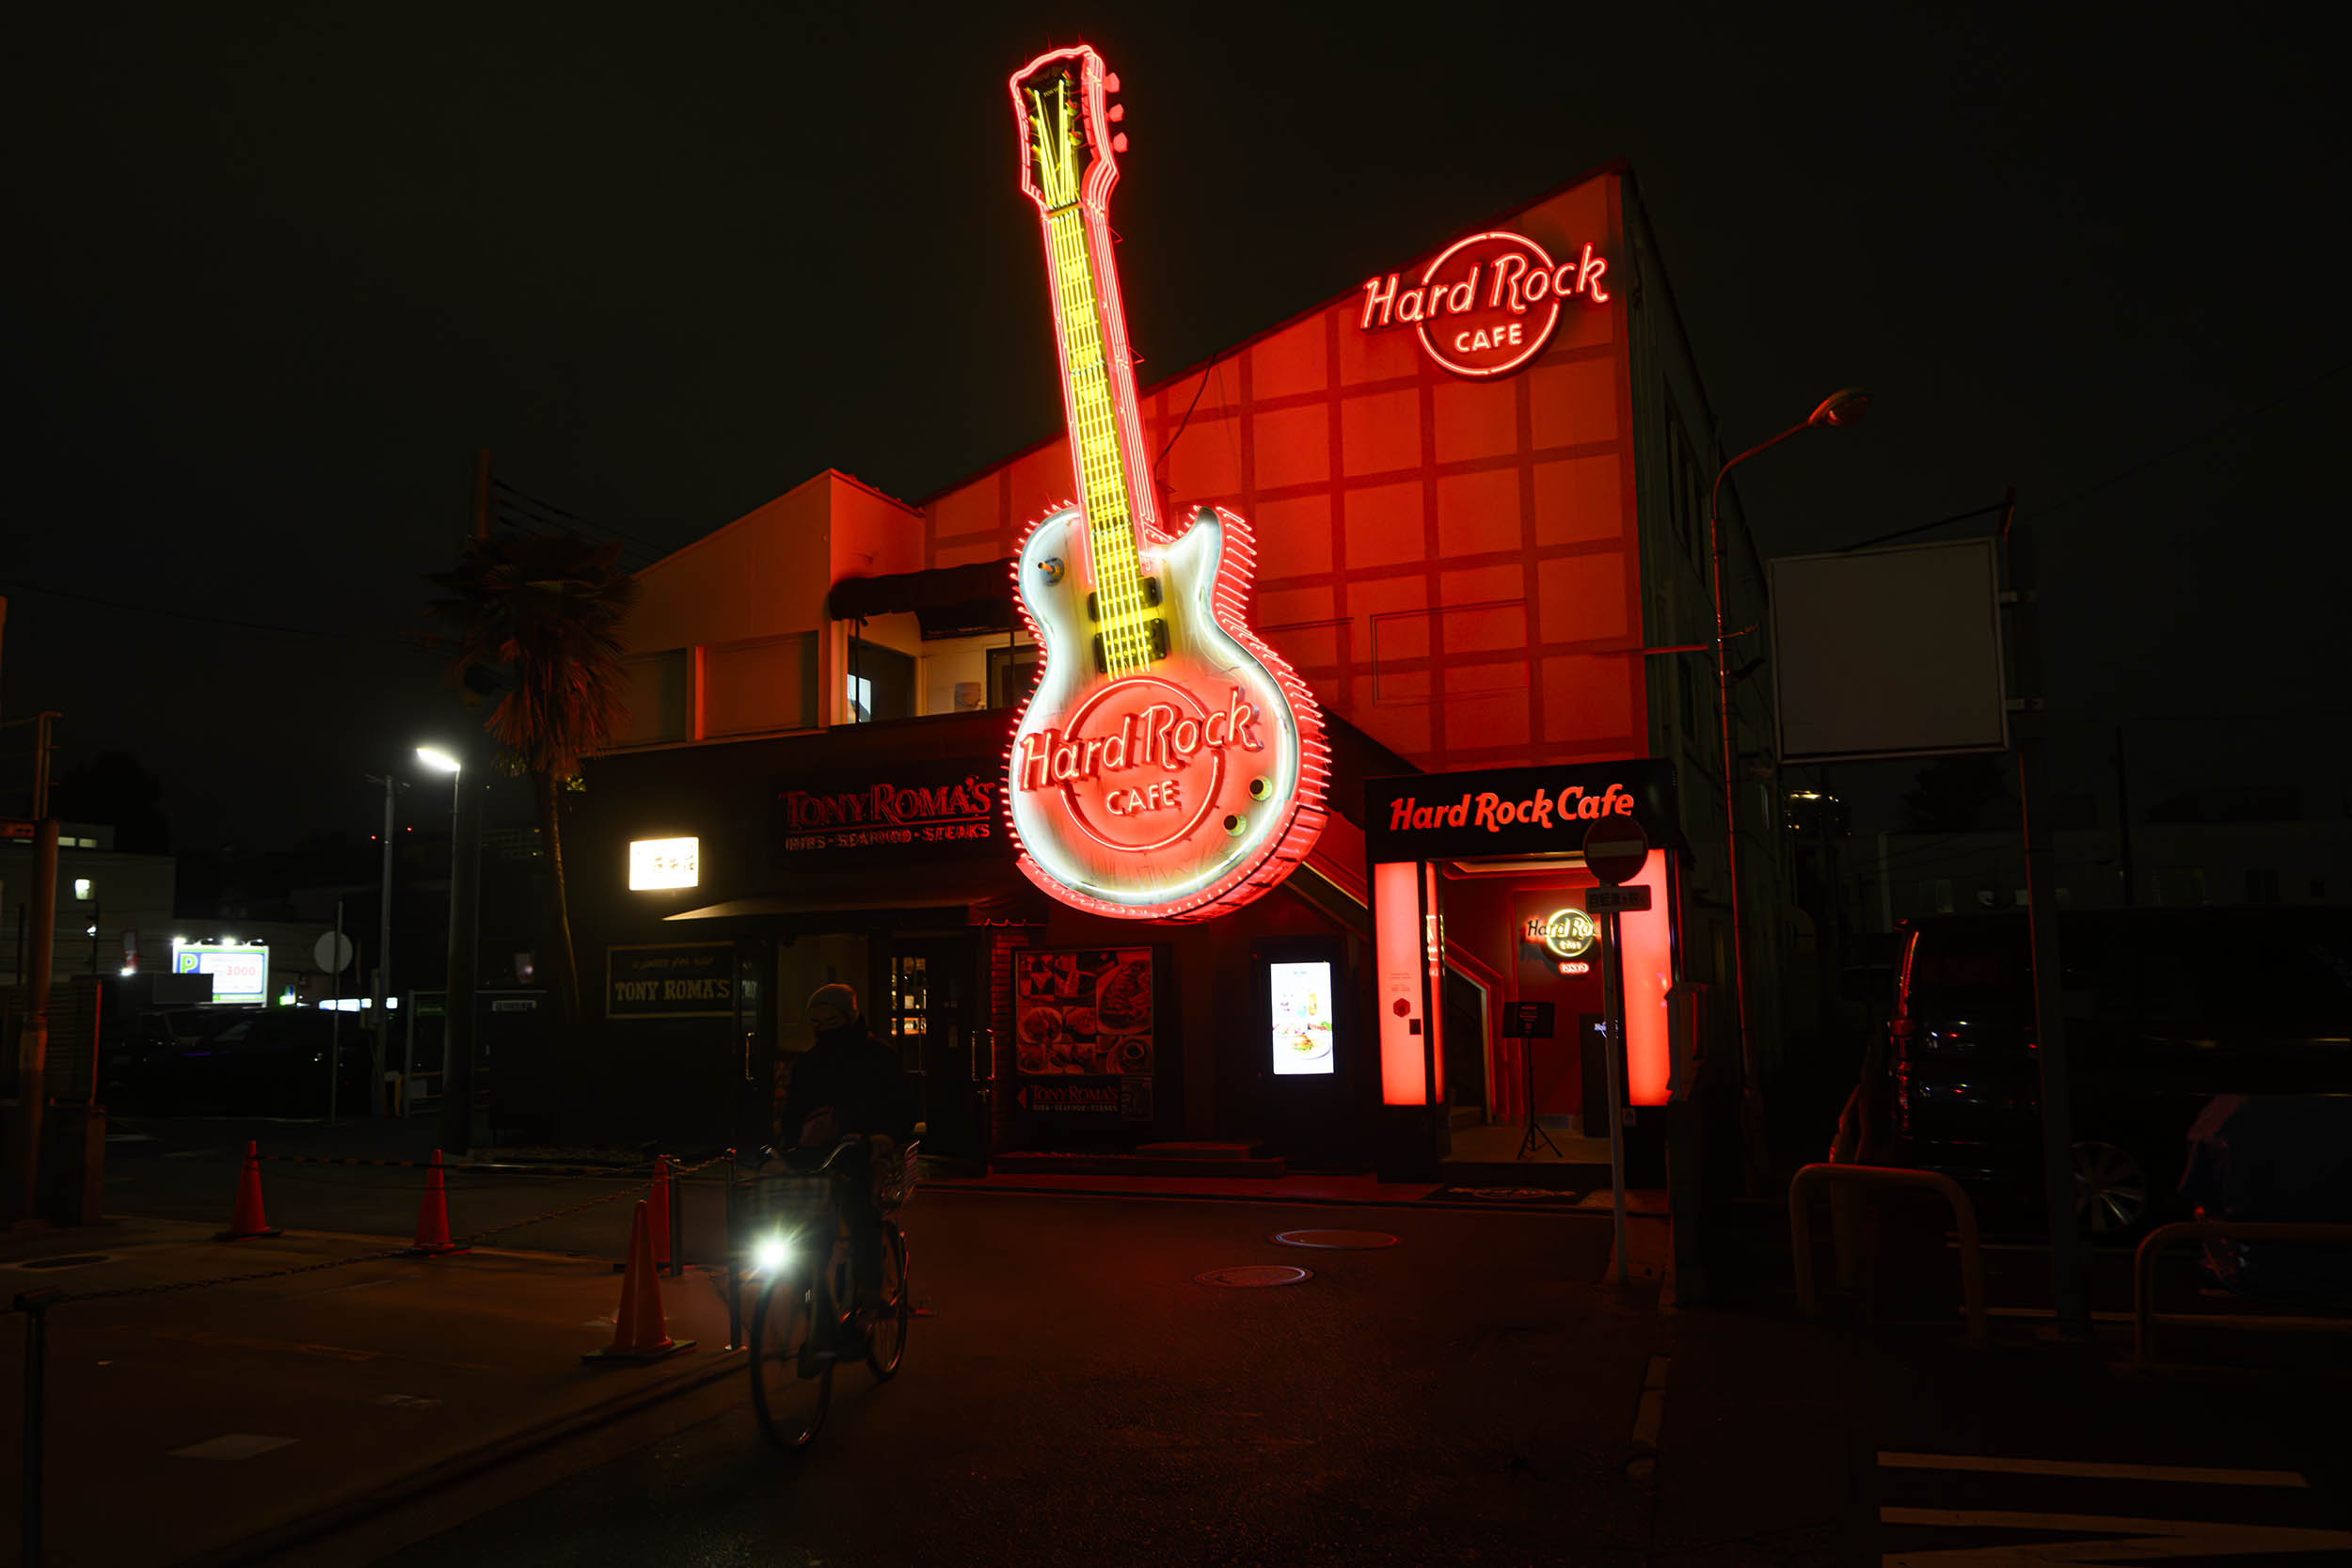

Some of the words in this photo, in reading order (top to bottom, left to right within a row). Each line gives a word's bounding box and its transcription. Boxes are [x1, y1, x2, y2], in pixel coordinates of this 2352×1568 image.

[1360, 261, 1483, 330] Hard
[1489, 242, 1610, 315] Rock
[1454, 323, 1523, 353] CAFE
[1020, 712, 1136, 792] Hard
[1139, 686, 1264, 771] Rock
[779, 790, 869, 829] TONY
[870, 774, 995, 825] ROMA'S
[1106, 780, 1179, 816] CAFE
[1390, 793, 1471, 832] Hard
[1474, 788, 1553, 832] Rock
[1557, 784, 1635, 821] Cafe
[1527, 917, 1569, 937] Hard
[180, 953, 199, 974] P
[613, 979, 660, 1002] TONY
[661, 978, 731, 1002] ROMA'S
